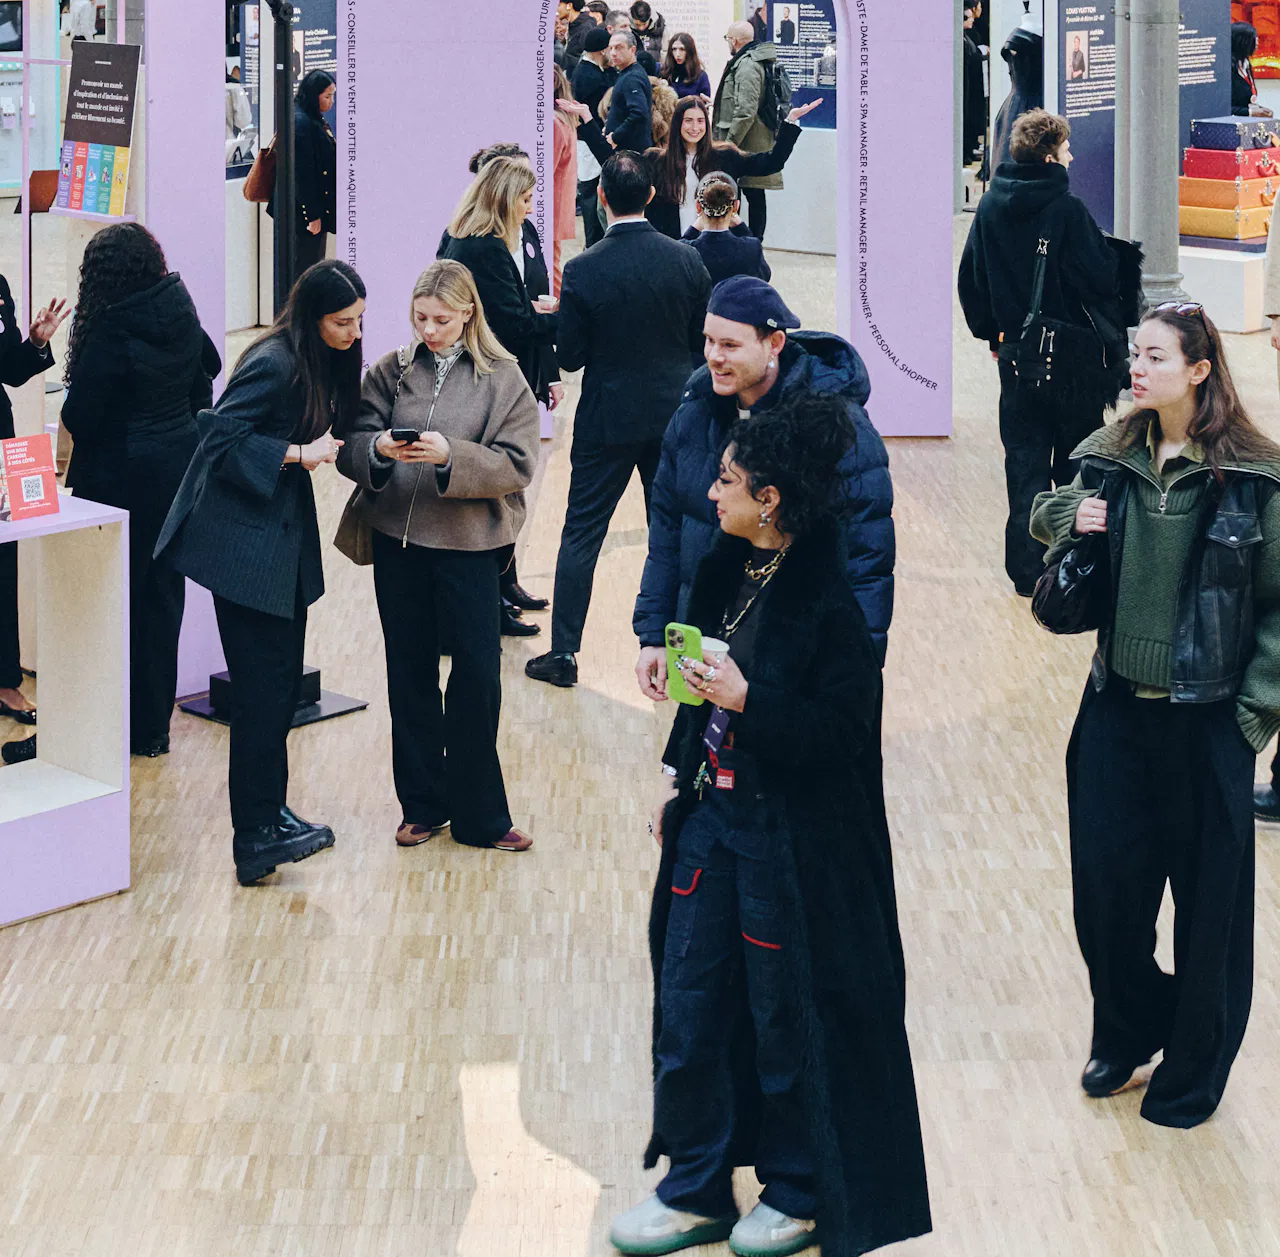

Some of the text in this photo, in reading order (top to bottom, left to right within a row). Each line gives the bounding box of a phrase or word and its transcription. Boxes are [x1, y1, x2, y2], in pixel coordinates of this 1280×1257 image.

[347, 13, 356, 70] CONSEILLER
[860, 25, 869, 52] DAME
[860, 54, 869, 66] DE
[347, 72, 356, 83] DE
[536, 50, 545, 108] BOULANGER
[860, 67, 869, 96] TABLE
[348, 85, 356, 115] VENTE
[860, 103, 868, 120] SPA
[536, 109, 545, 132] CHEF
[348, 123, 356, 162] BOTTIER
[859, 121, 868, 168] MANAGER
[537, 141, 545, 192] COLORISTE
[346, 169, 357, 229] MAQUILLEUR
[859, 175, 868, 206] RETAIL
[859, 207, 868, 254] MANAGER
[348, 237, 357, 267] SERTIS
[859, 261, 873, 319] PATRONNIER
[868, 324, 900, 367] PERSONAL
[898, 363, 938, 391] SHOPPER
